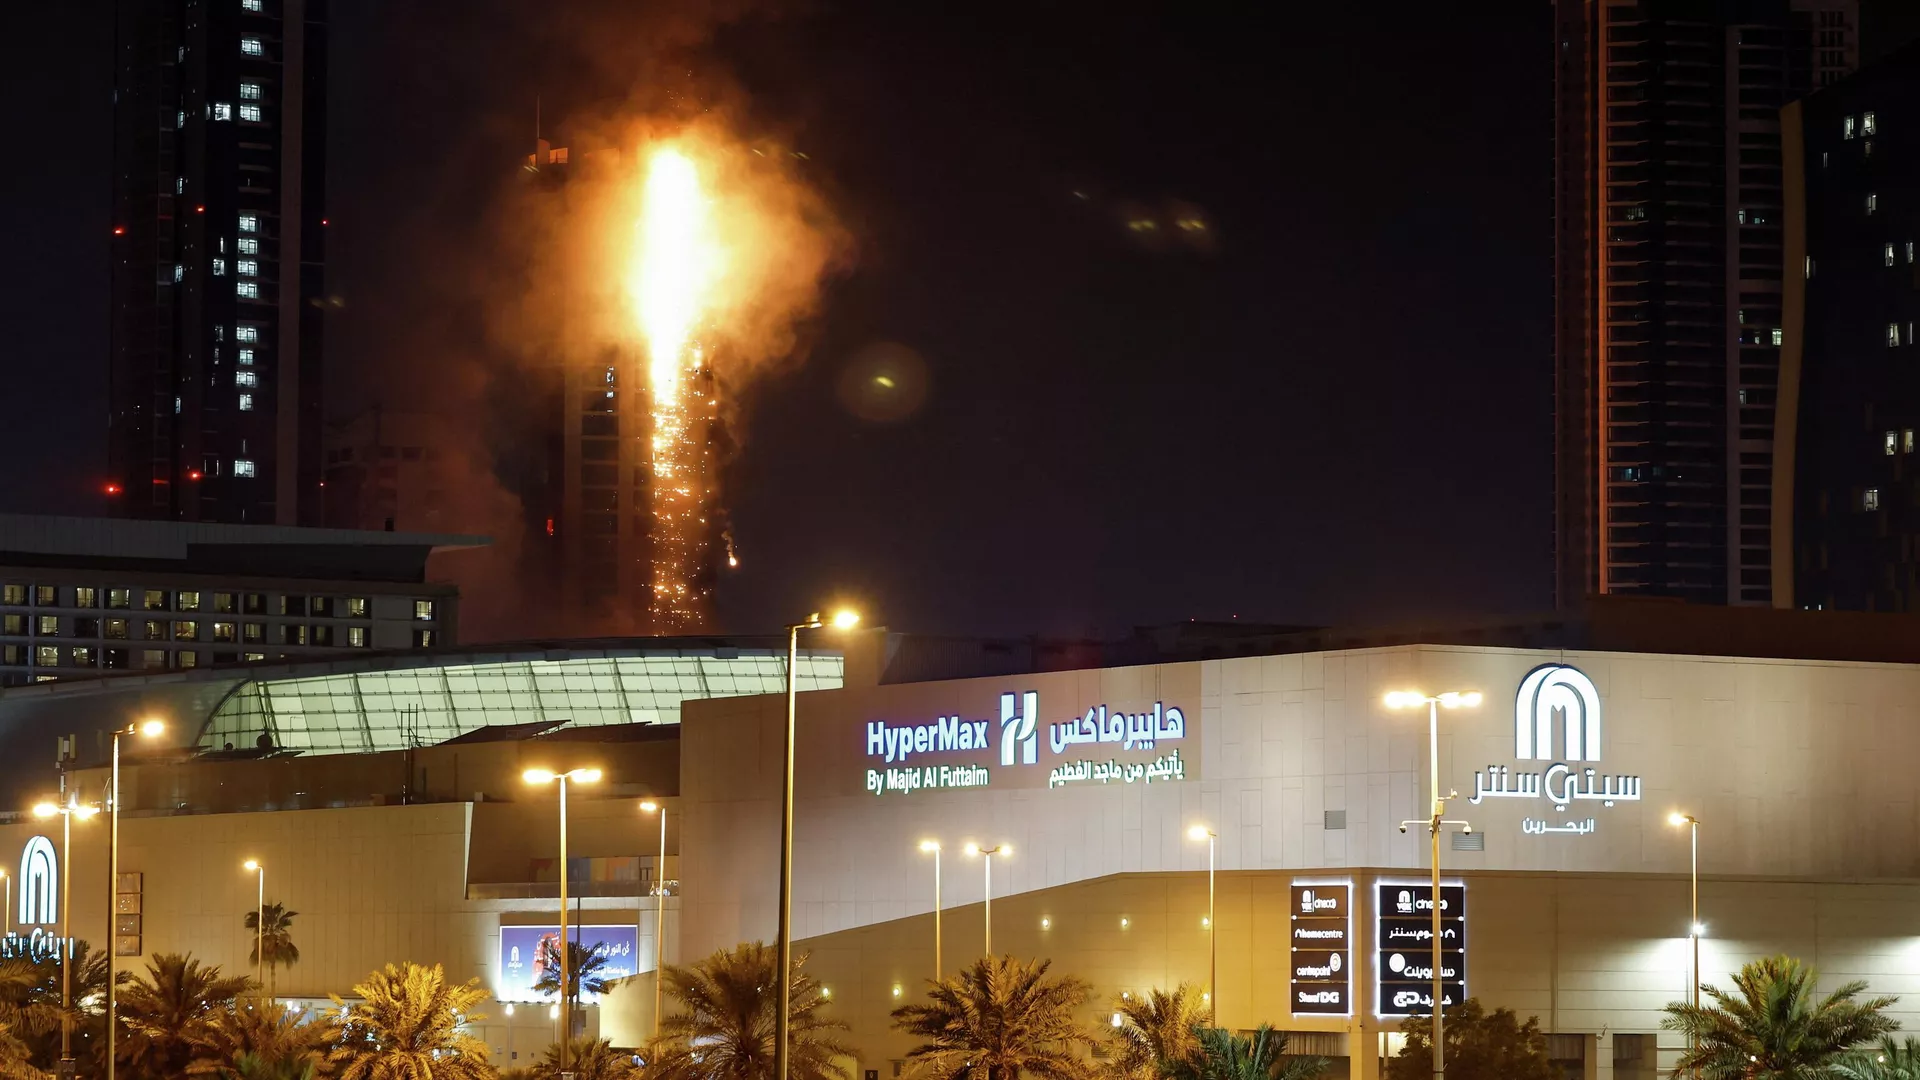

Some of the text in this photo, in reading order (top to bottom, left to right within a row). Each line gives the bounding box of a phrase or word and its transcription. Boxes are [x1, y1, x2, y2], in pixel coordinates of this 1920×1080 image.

[867, 716, 988, 763] HyperMax
[1049, 701, 1185, 755] هايبرماكس
[867, 764, 989, 796] By Majid Al Futtaim
[1049, 759, 1092, 789] الفطيم
[1093, 759, 1123, 784] ماجد
[1124, 763, 1145, 783] من
[1468, 763, 1641, 812] سيتي سنتر
[1522, 816, 1595, 836] البحرين
[1320, 991, 1340, 1003] DG
